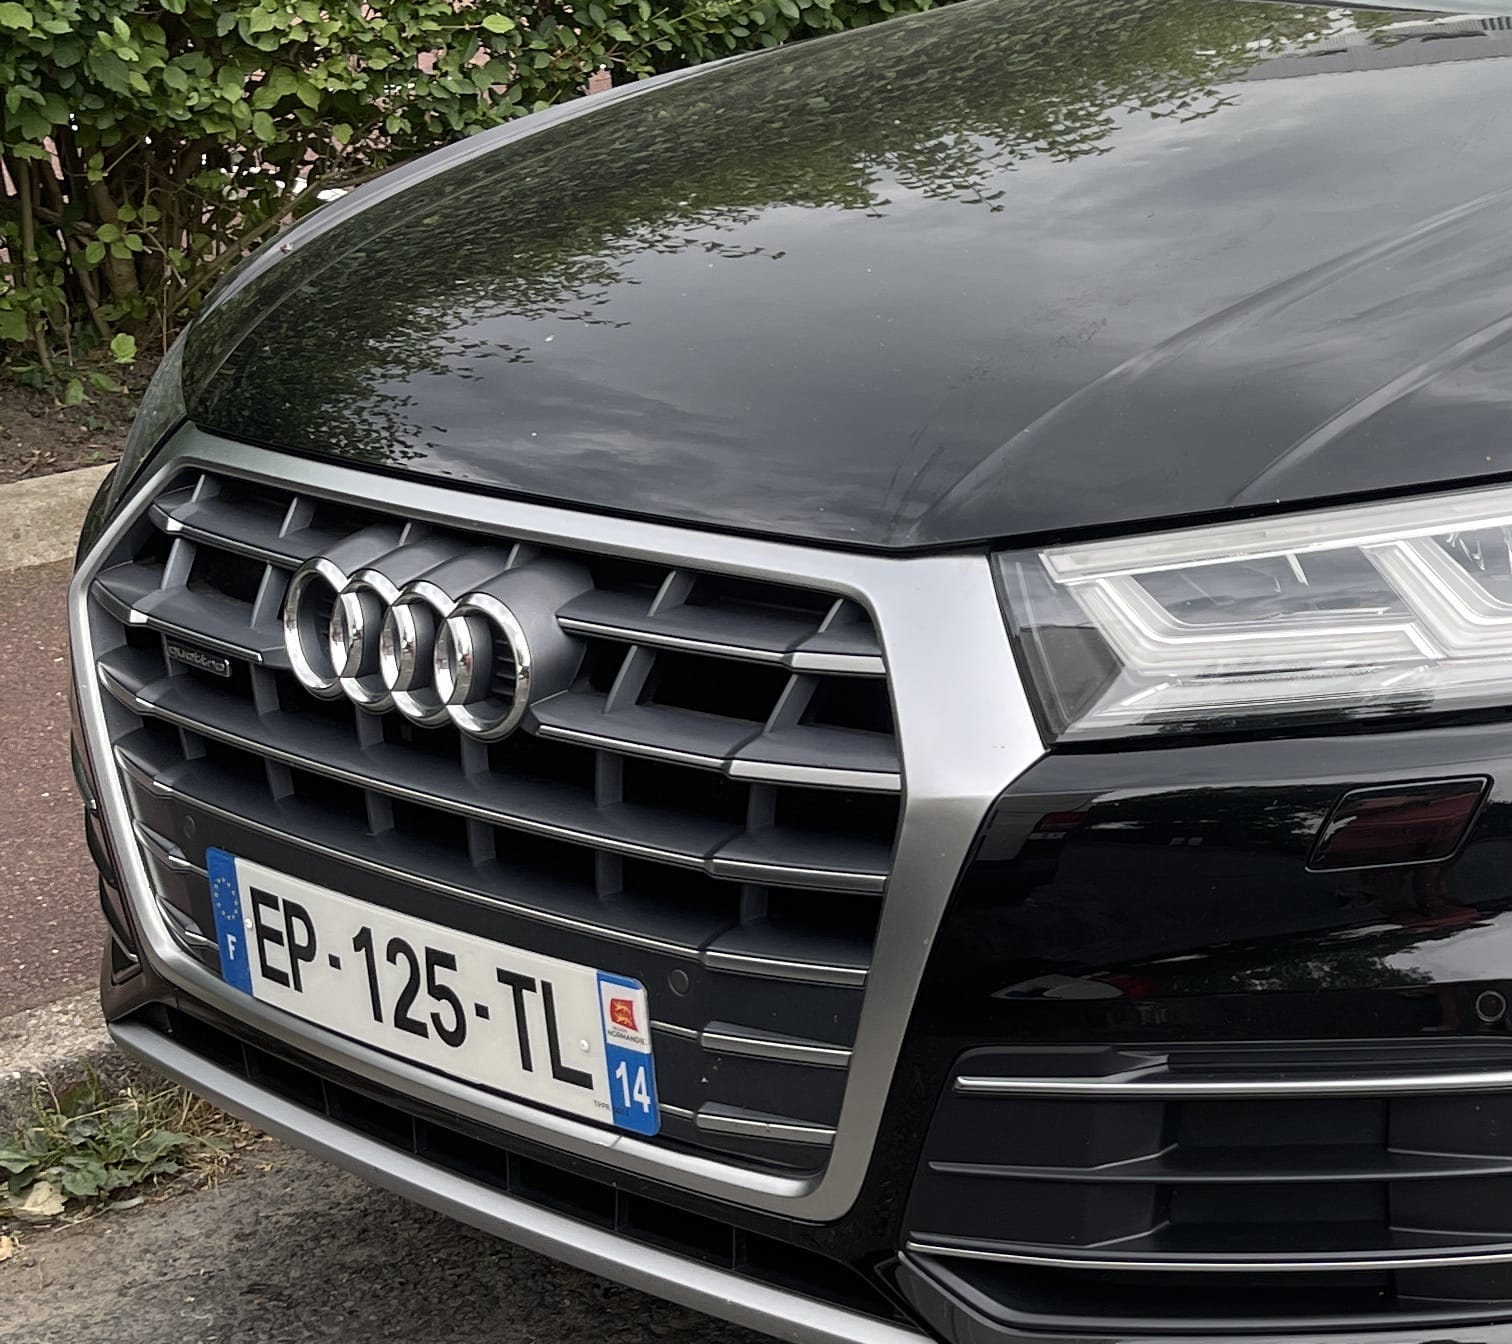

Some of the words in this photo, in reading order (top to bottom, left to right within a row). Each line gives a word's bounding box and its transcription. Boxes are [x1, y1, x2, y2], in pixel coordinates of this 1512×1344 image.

[168, 646, 225, 672] quattro
[225, 933, 237, 961] F
[249, 885, 595, 1091] EP-125-TL
[615, 1060, 652, 1114] 14
